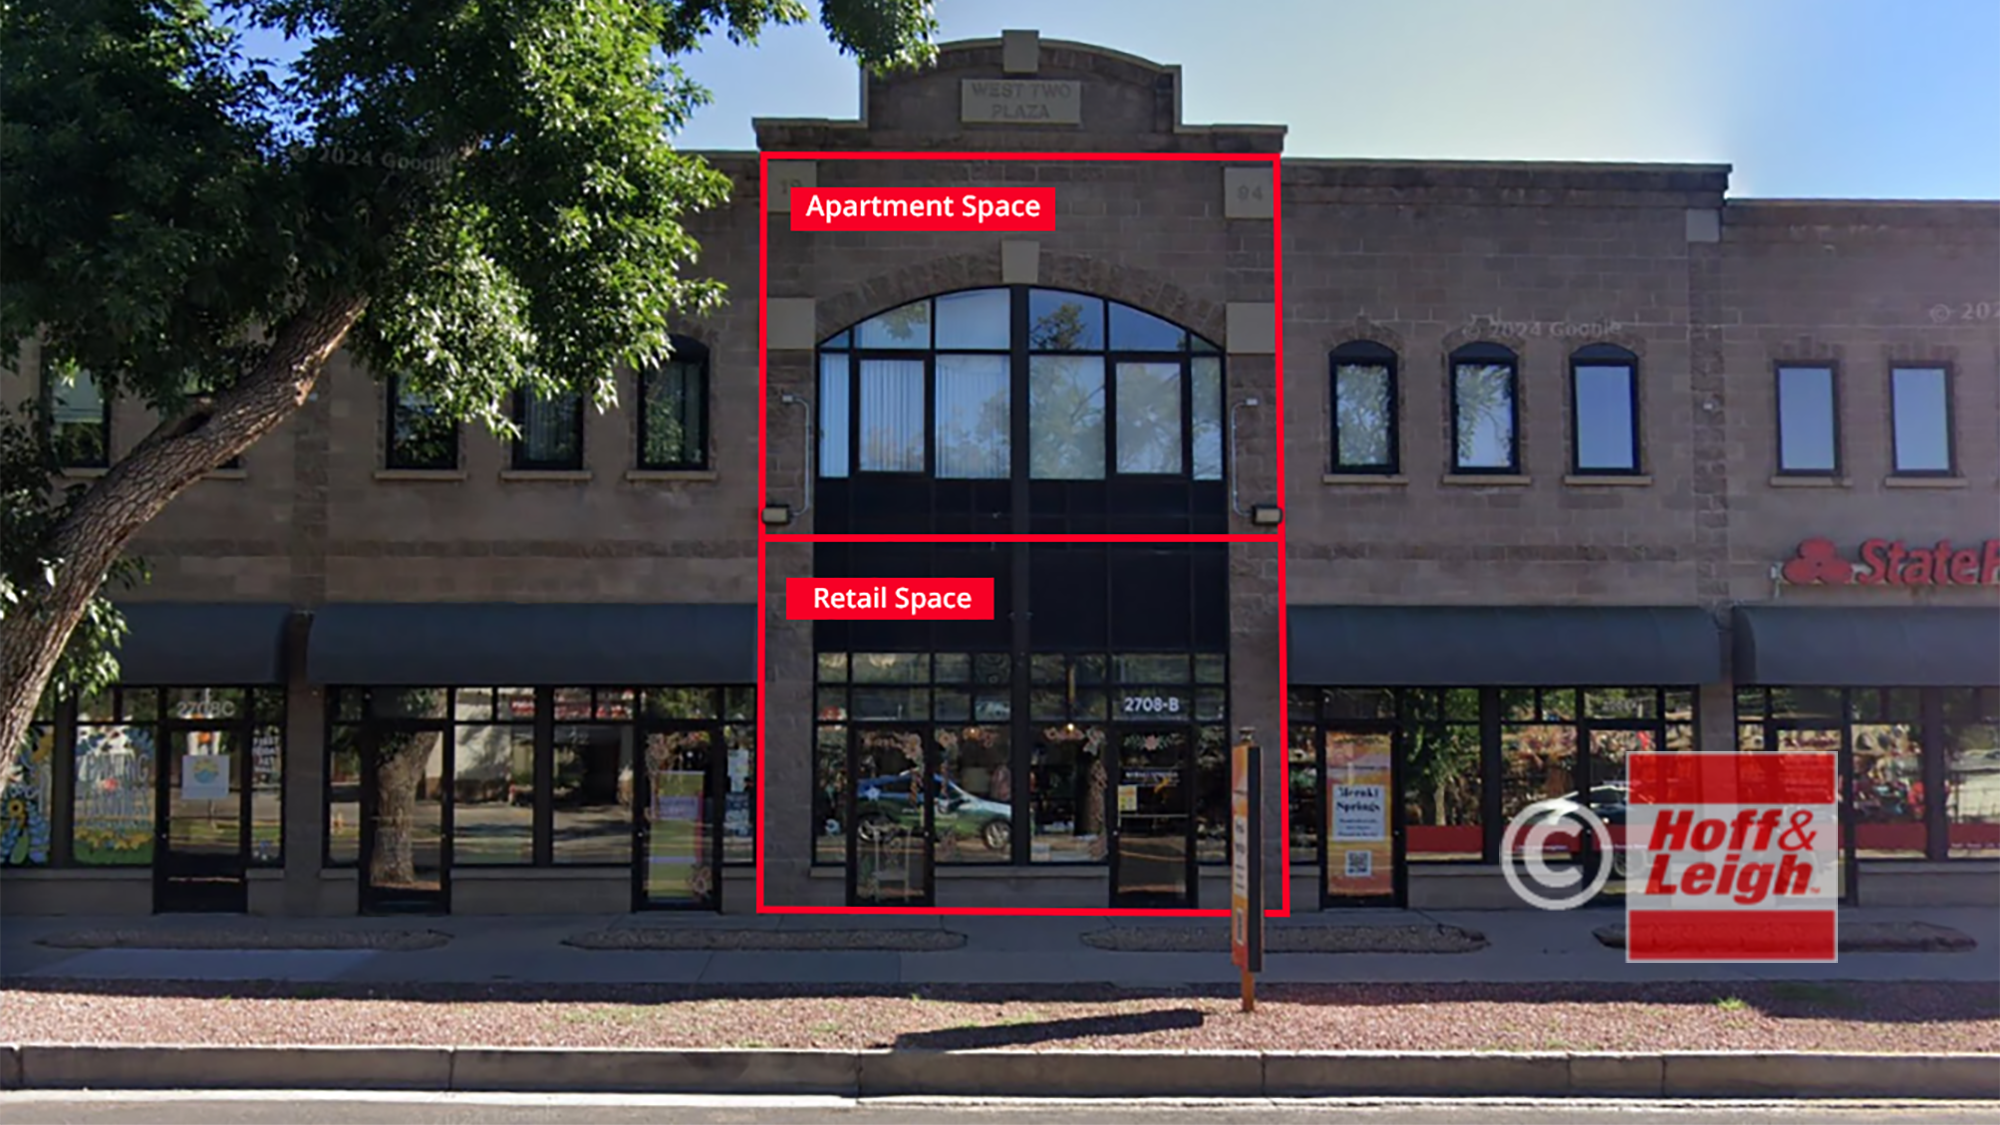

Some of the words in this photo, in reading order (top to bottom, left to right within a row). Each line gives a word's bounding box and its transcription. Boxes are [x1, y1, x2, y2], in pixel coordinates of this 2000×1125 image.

[972, 82, 1024, 98] WEST
[1028, 83, 1072, 98] TWO
[991, 104, 1051, 119] PLAZA
[1124, 697, 1180, 712] 2708-B
